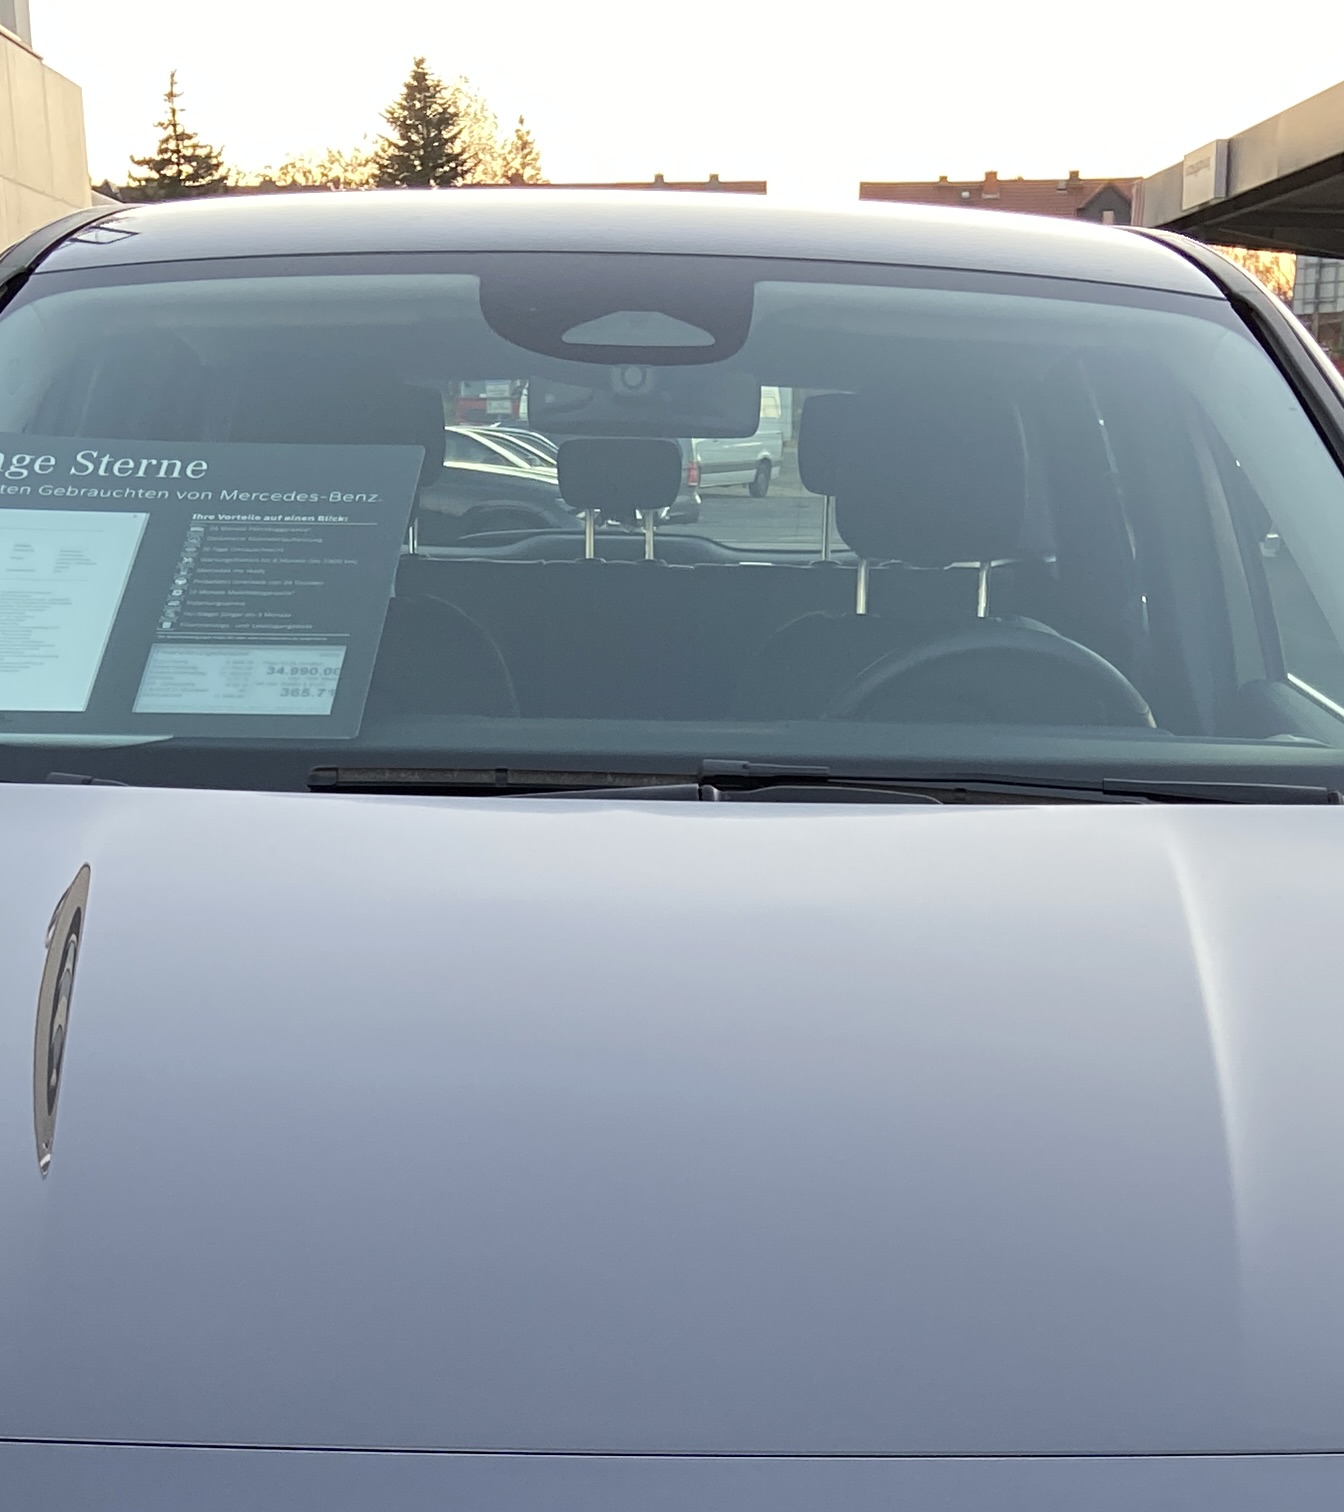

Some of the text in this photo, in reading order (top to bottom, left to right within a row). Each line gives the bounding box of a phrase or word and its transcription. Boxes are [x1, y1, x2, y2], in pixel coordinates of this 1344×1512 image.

[70, 450, 208, 480] Sterne
[38, 484, 168, 500] Gebrauchten
[176, 489, 212, 500] von
[192, 513, 215, 521] Ihre
[217, 513, 261, 522] Vorteile
[263, 514, 283, 522] auf
